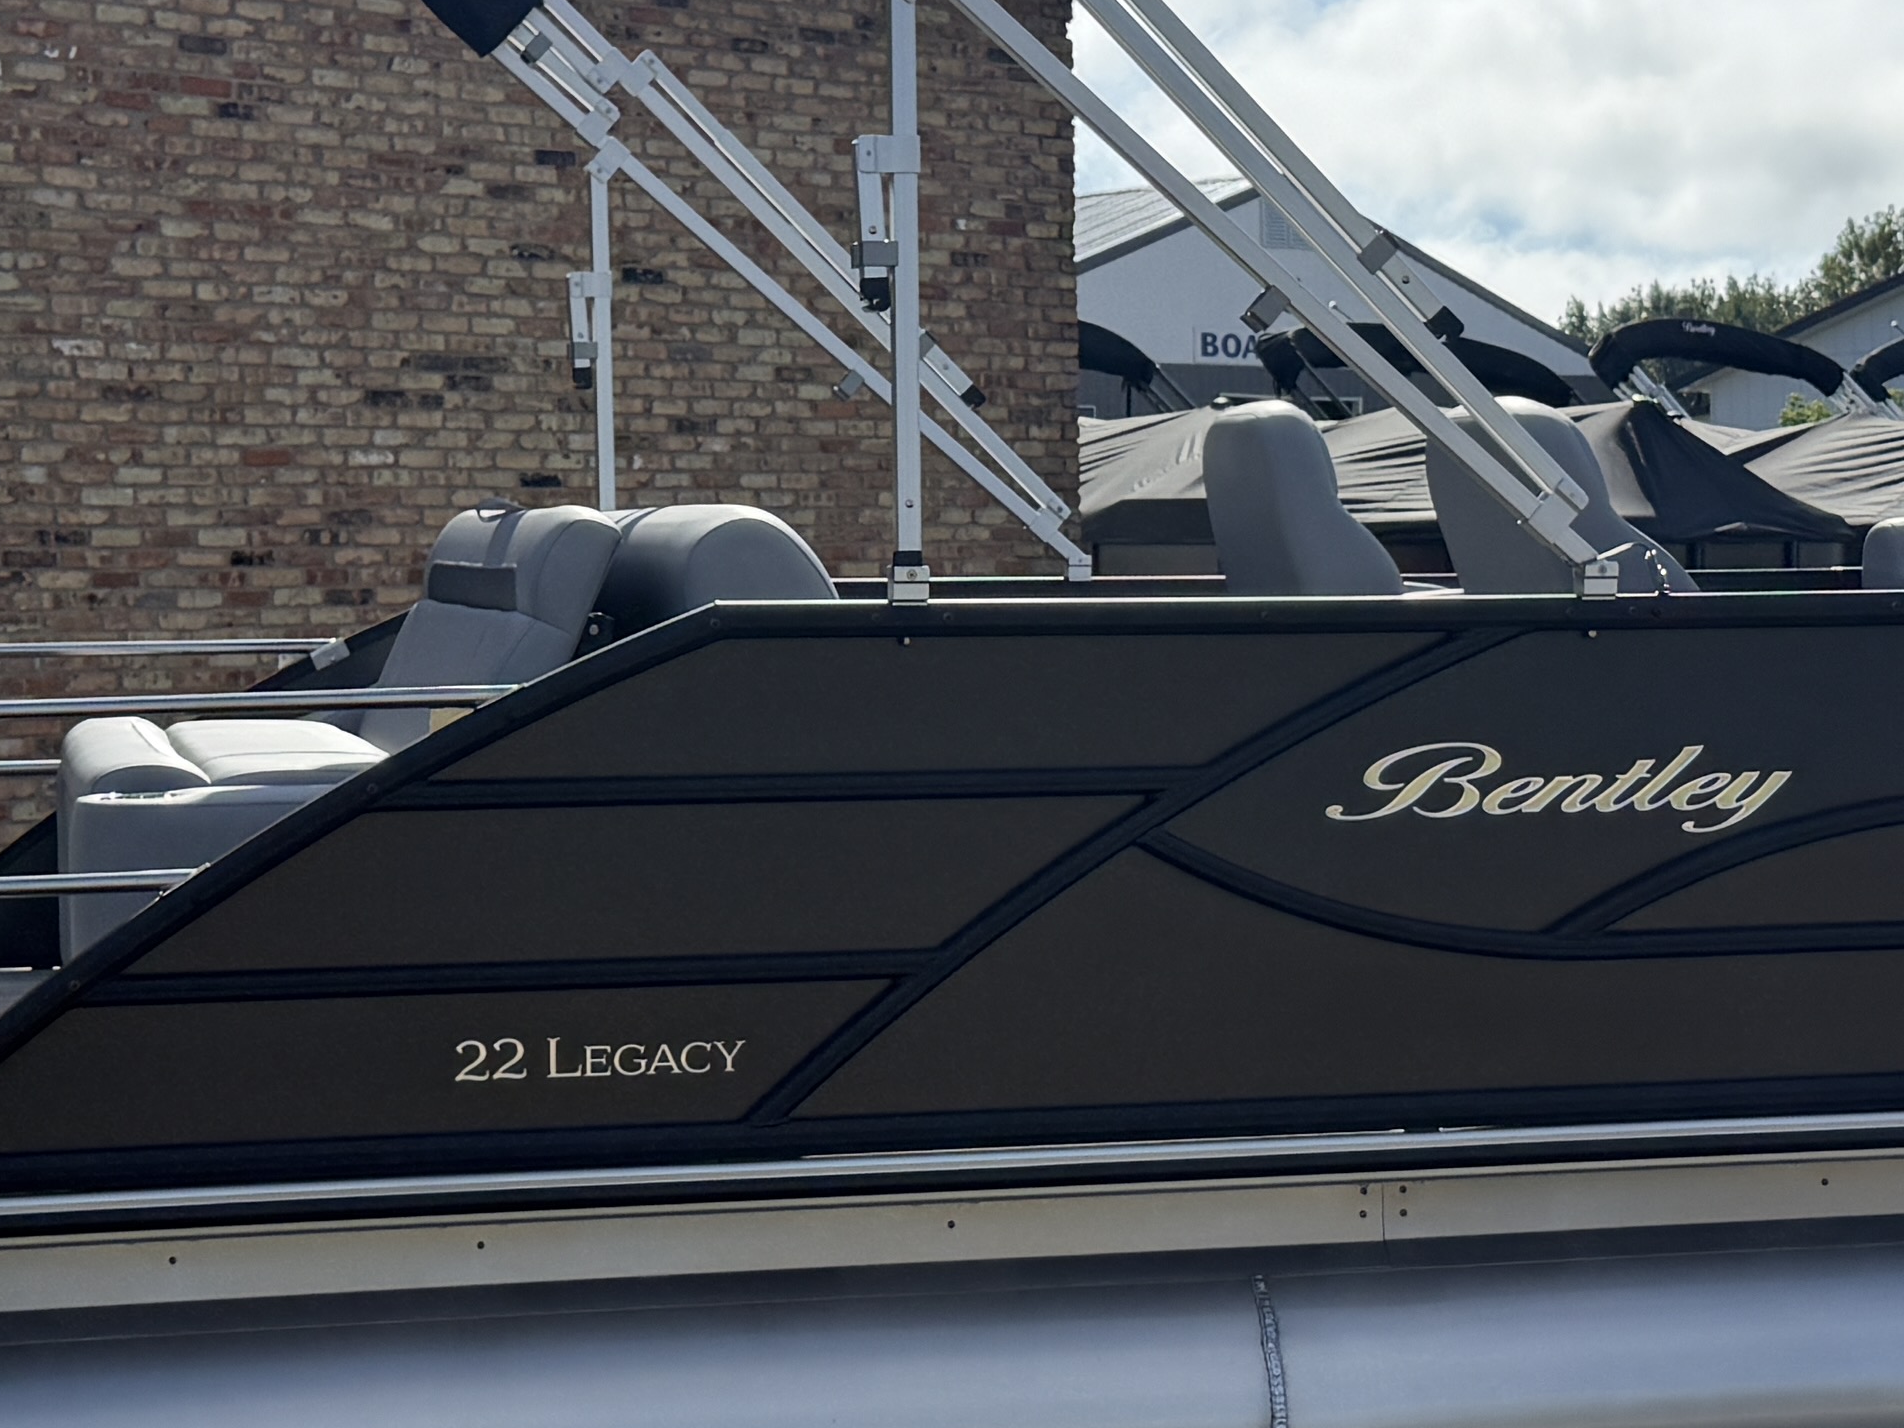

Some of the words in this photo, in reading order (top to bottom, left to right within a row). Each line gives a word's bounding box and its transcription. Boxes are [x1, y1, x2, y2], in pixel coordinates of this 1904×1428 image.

[1201, 332, 1259, 359] BOA
[1325, 741, 1793, 833] Bentley
[454, 1038, 527, 1082] 22
